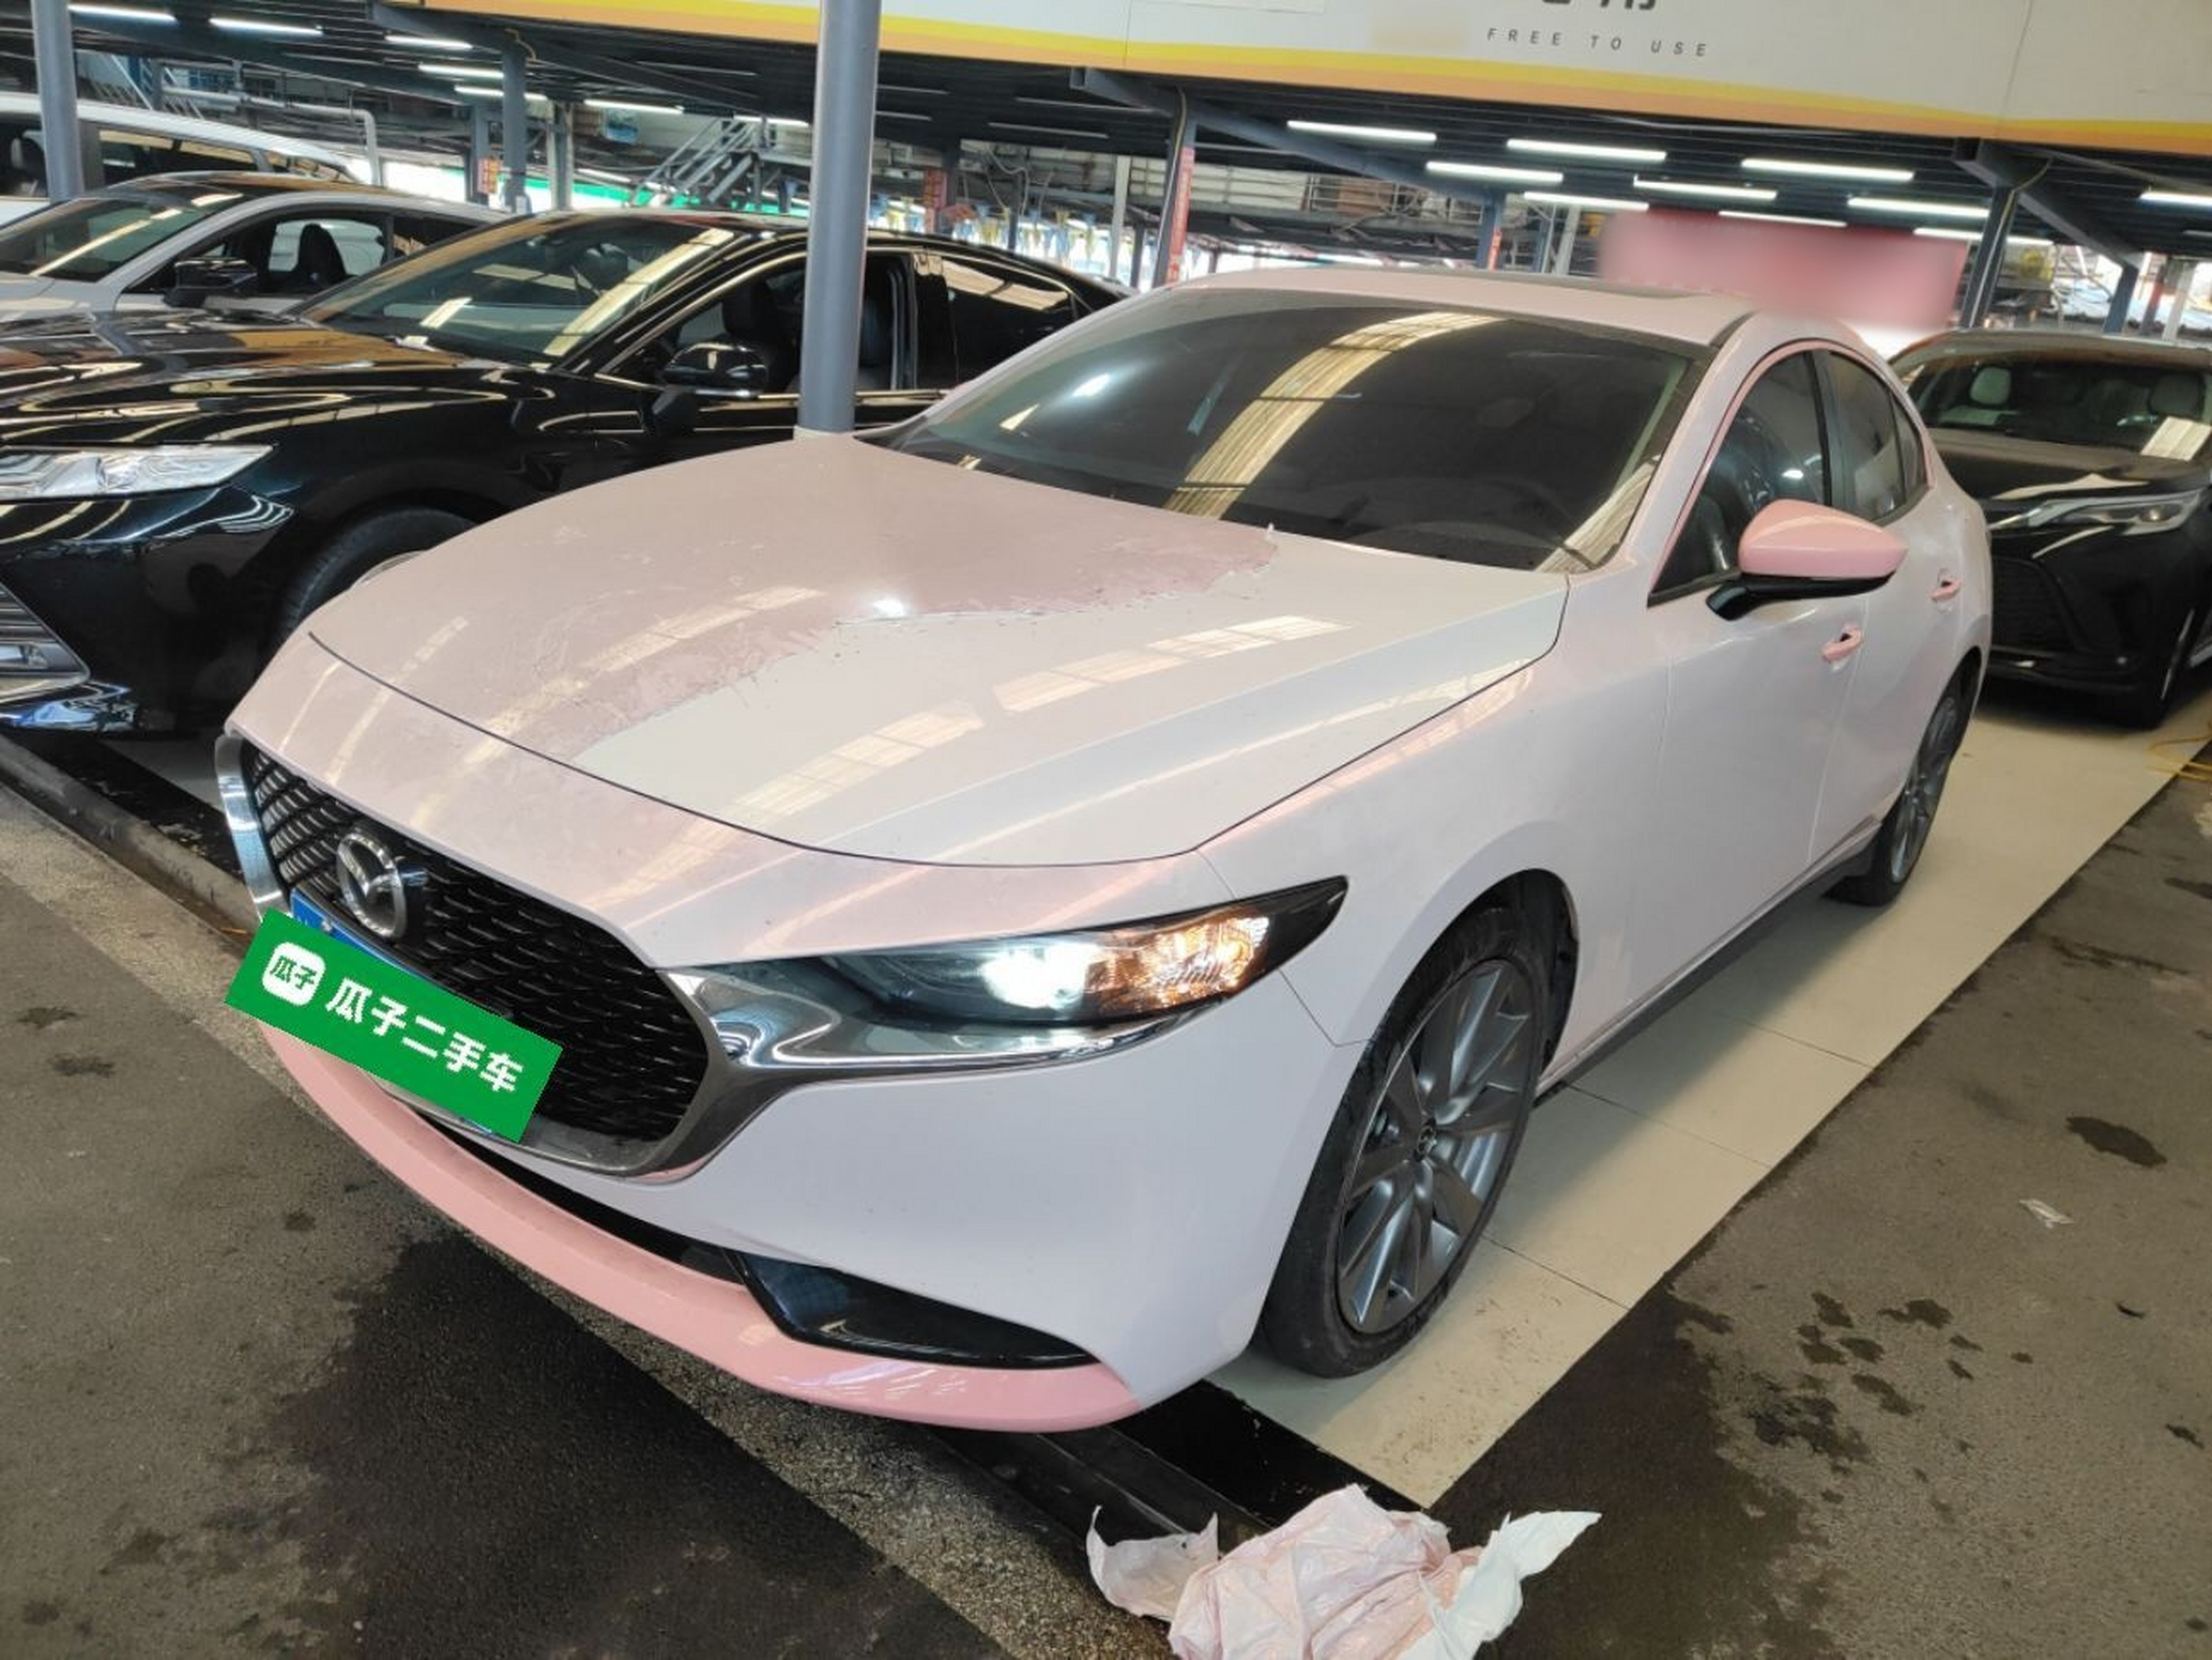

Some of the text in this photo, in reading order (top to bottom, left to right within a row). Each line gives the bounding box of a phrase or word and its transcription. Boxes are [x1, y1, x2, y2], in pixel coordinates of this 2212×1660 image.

[1487, 28, 1706, 56] FREE TO USE
